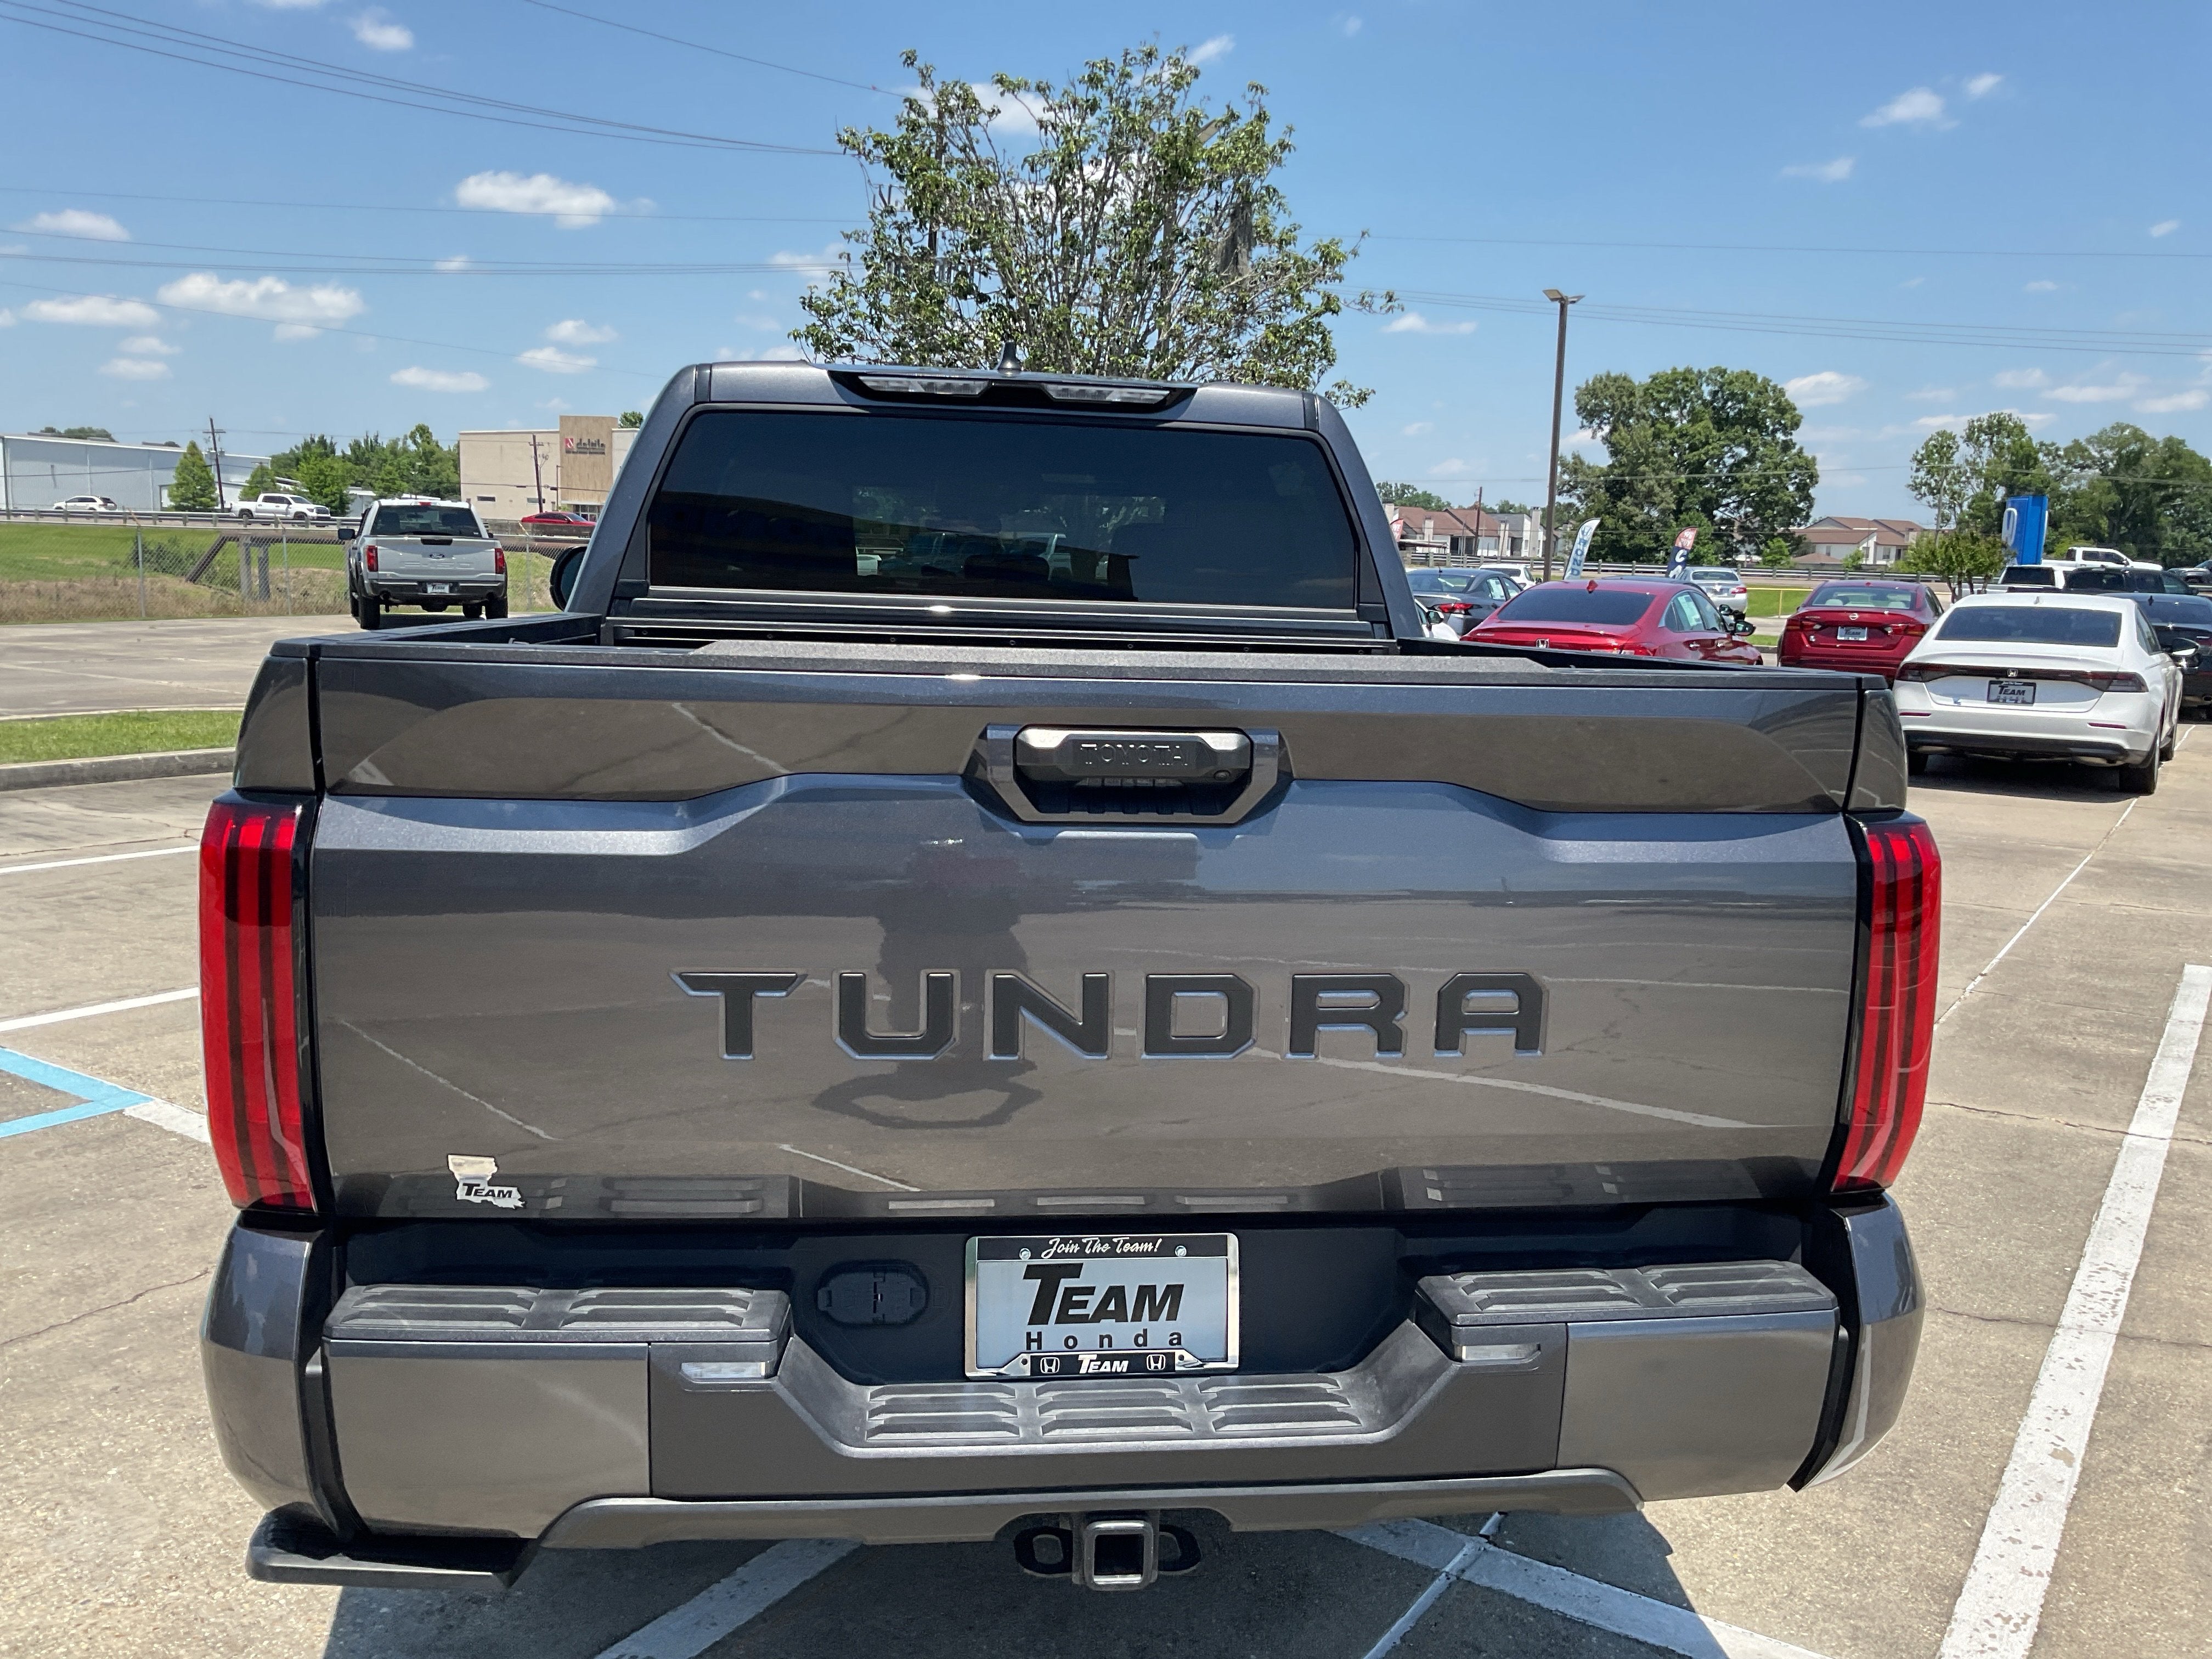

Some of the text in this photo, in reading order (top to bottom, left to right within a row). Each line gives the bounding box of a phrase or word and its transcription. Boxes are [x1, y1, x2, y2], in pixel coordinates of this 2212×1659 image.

[1998, 685, 2026, 696] TEAM
[1080, 744, 1189, 766] TOYOTA
[671, 970, 1547, 1060] TUNDRA
[462, 1182, 513, 1198] TEAM
[1041, 1237, 1163, 1259] Join The Team!
[1023, 1262, 1184, 1325] TEAM
[1026, 1328, 1182, 1350] Honda
[1077, 1353, 1129, 1374] TEAM
